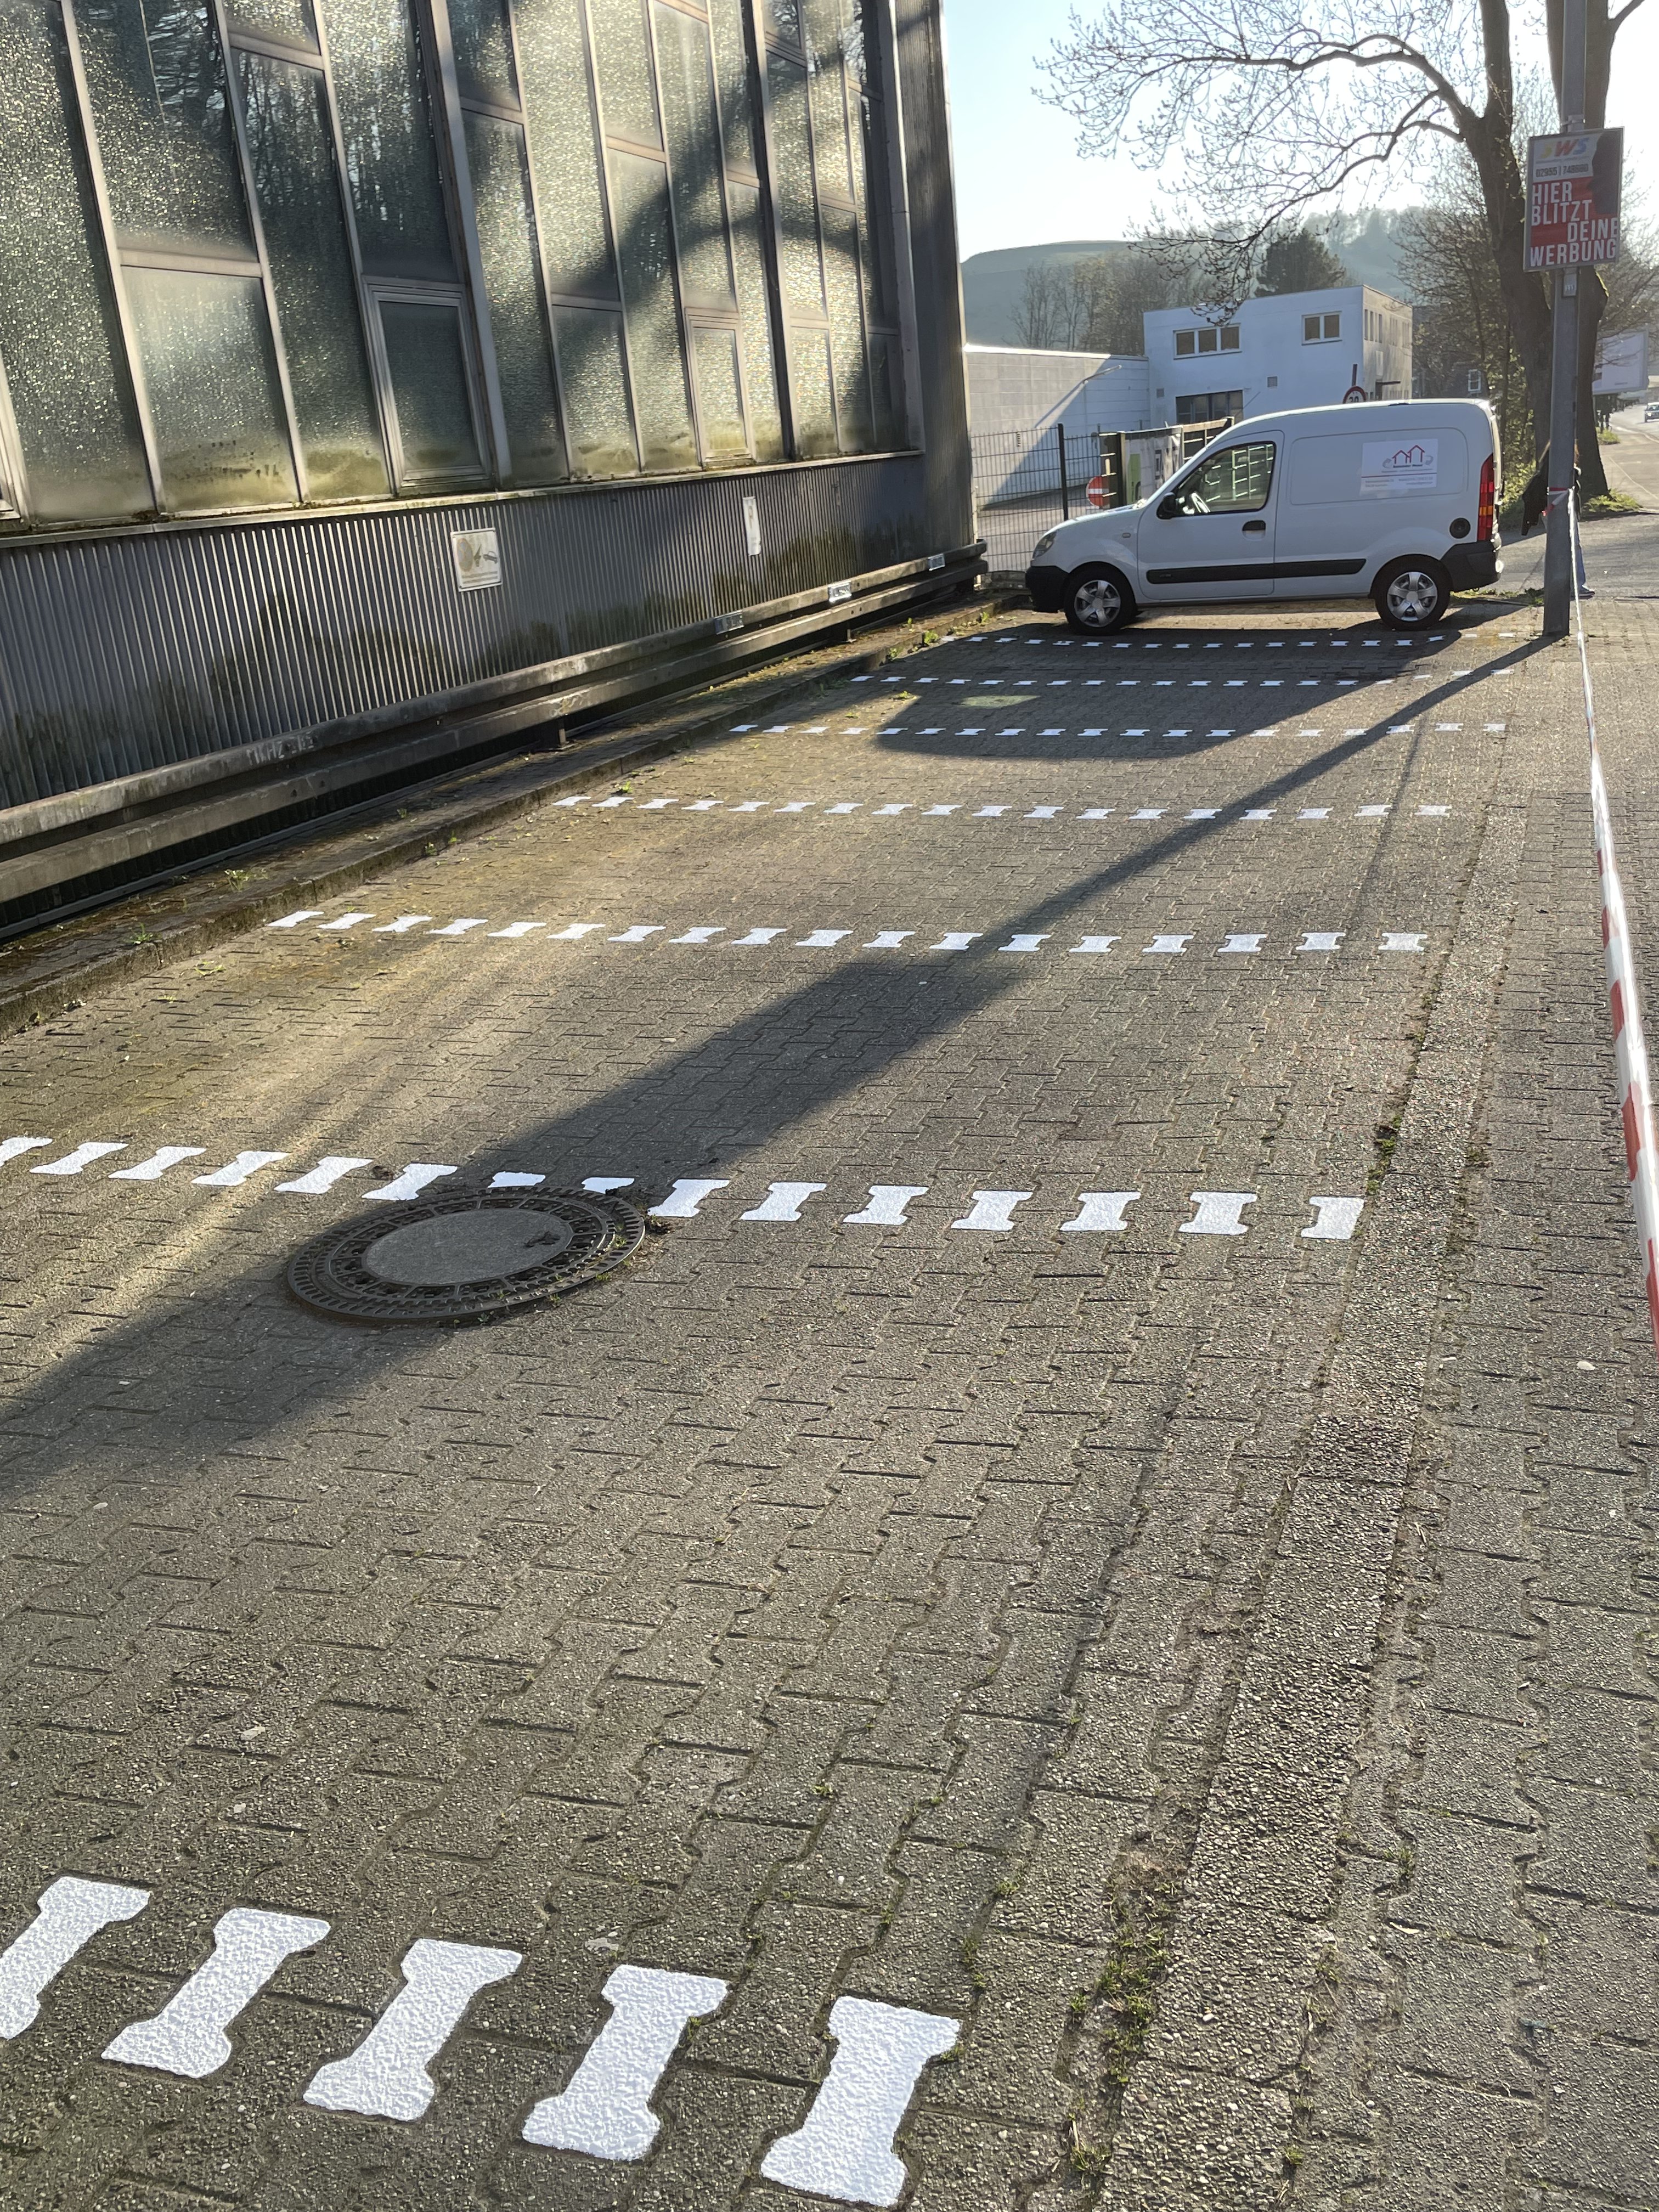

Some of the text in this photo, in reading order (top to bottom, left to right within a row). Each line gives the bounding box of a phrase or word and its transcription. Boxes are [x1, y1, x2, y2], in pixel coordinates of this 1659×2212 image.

[1532, 181, 1572, 205] HIER
[1532, 200, 1592, 226] BLITZT
[1567, 217, 1618, 242] DEINE
[1530, 239, 1616, 267] WERBUNG
